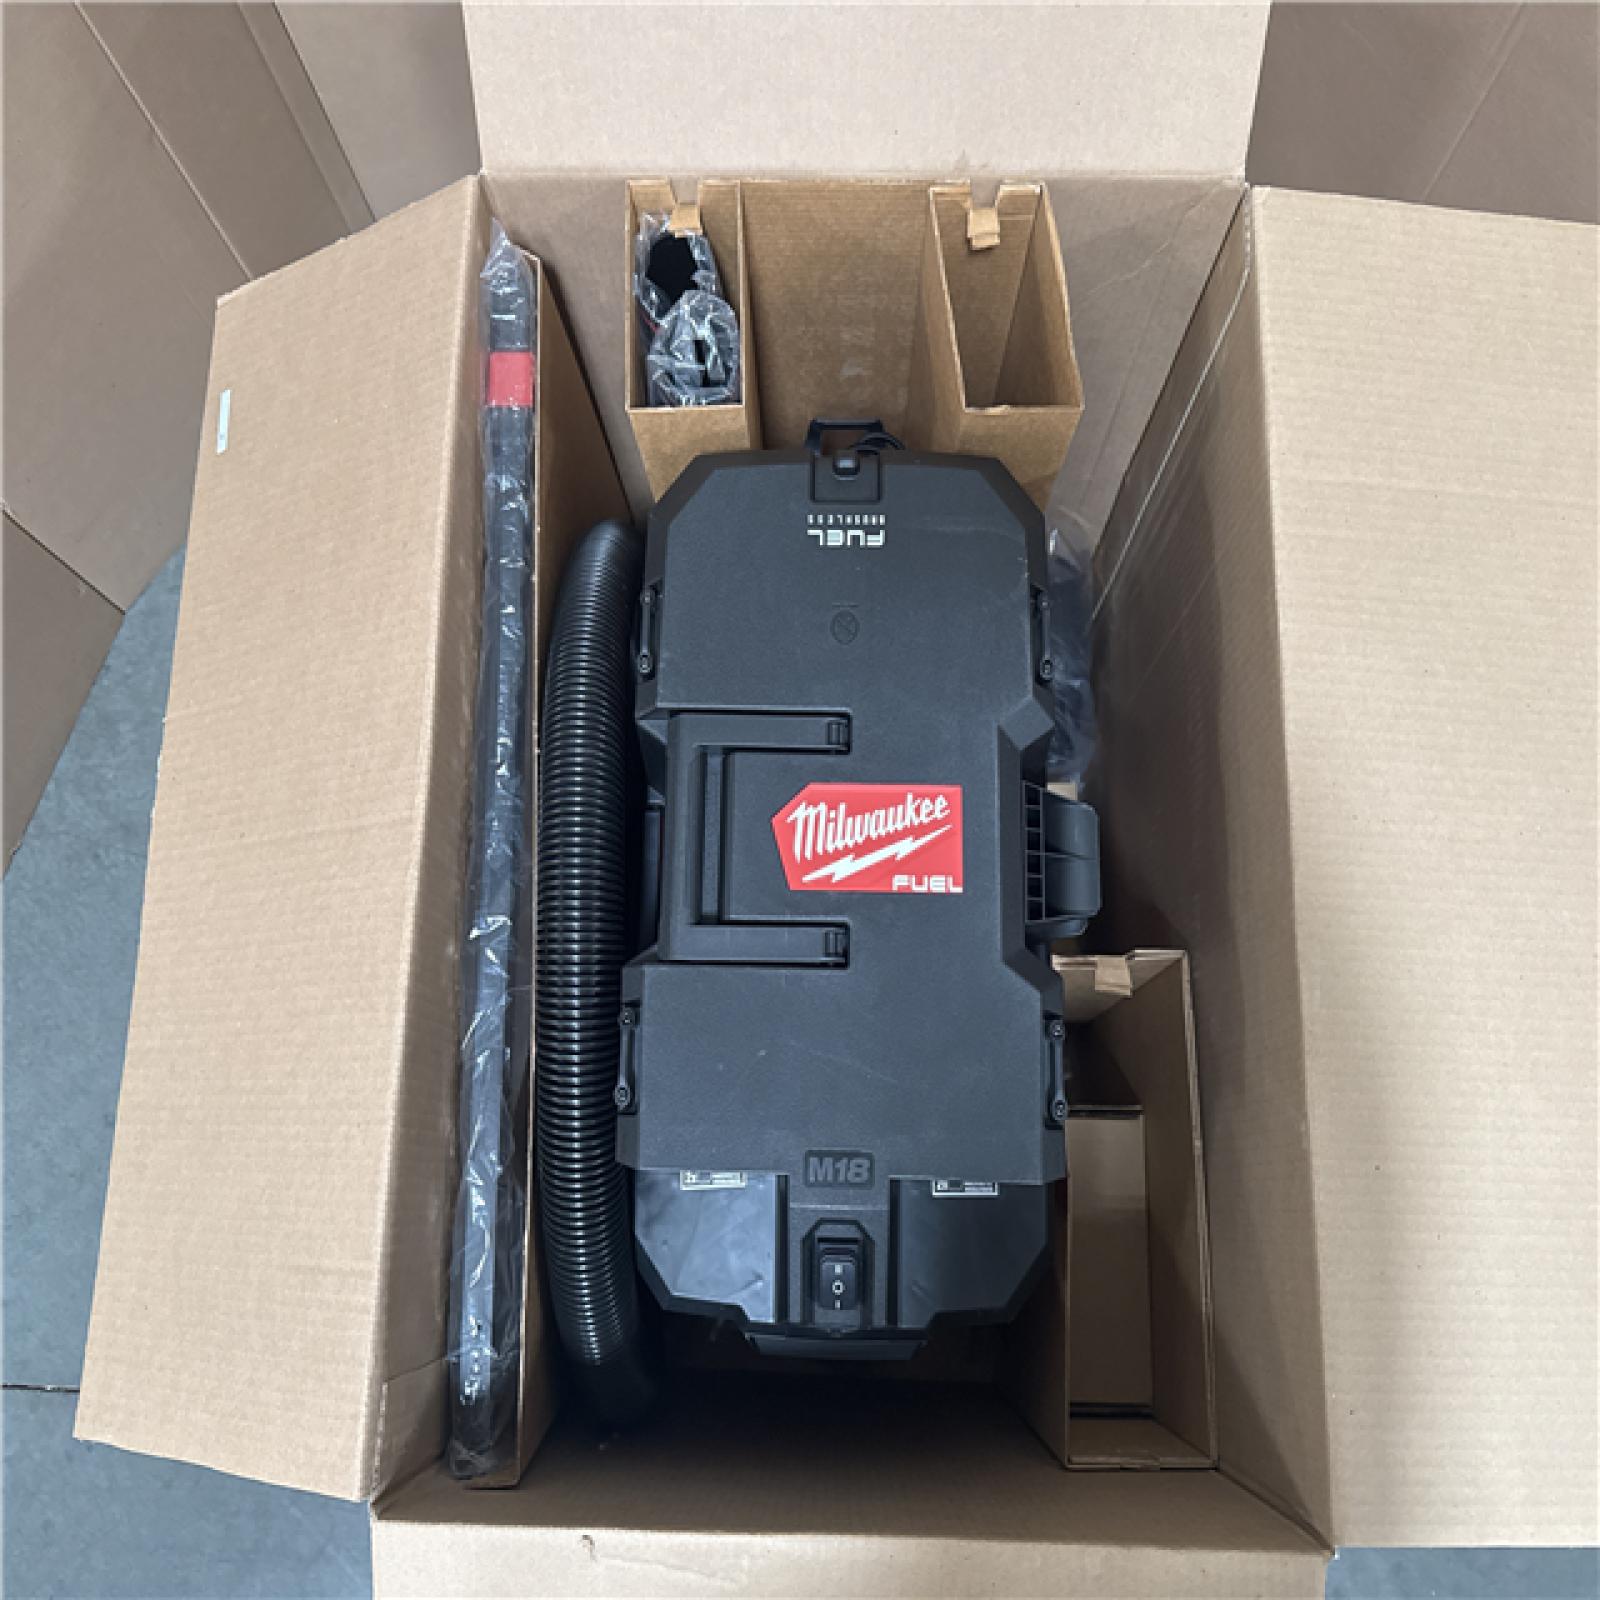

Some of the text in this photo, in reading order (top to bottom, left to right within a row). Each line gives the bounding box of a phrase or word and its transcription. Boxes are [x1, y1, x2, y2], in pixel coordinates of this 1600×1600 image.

[786, 792, 951, 863] Milwaukee
[892, 874, 964, 893] FUEL
[809, 1156, 871, 1184] M18
